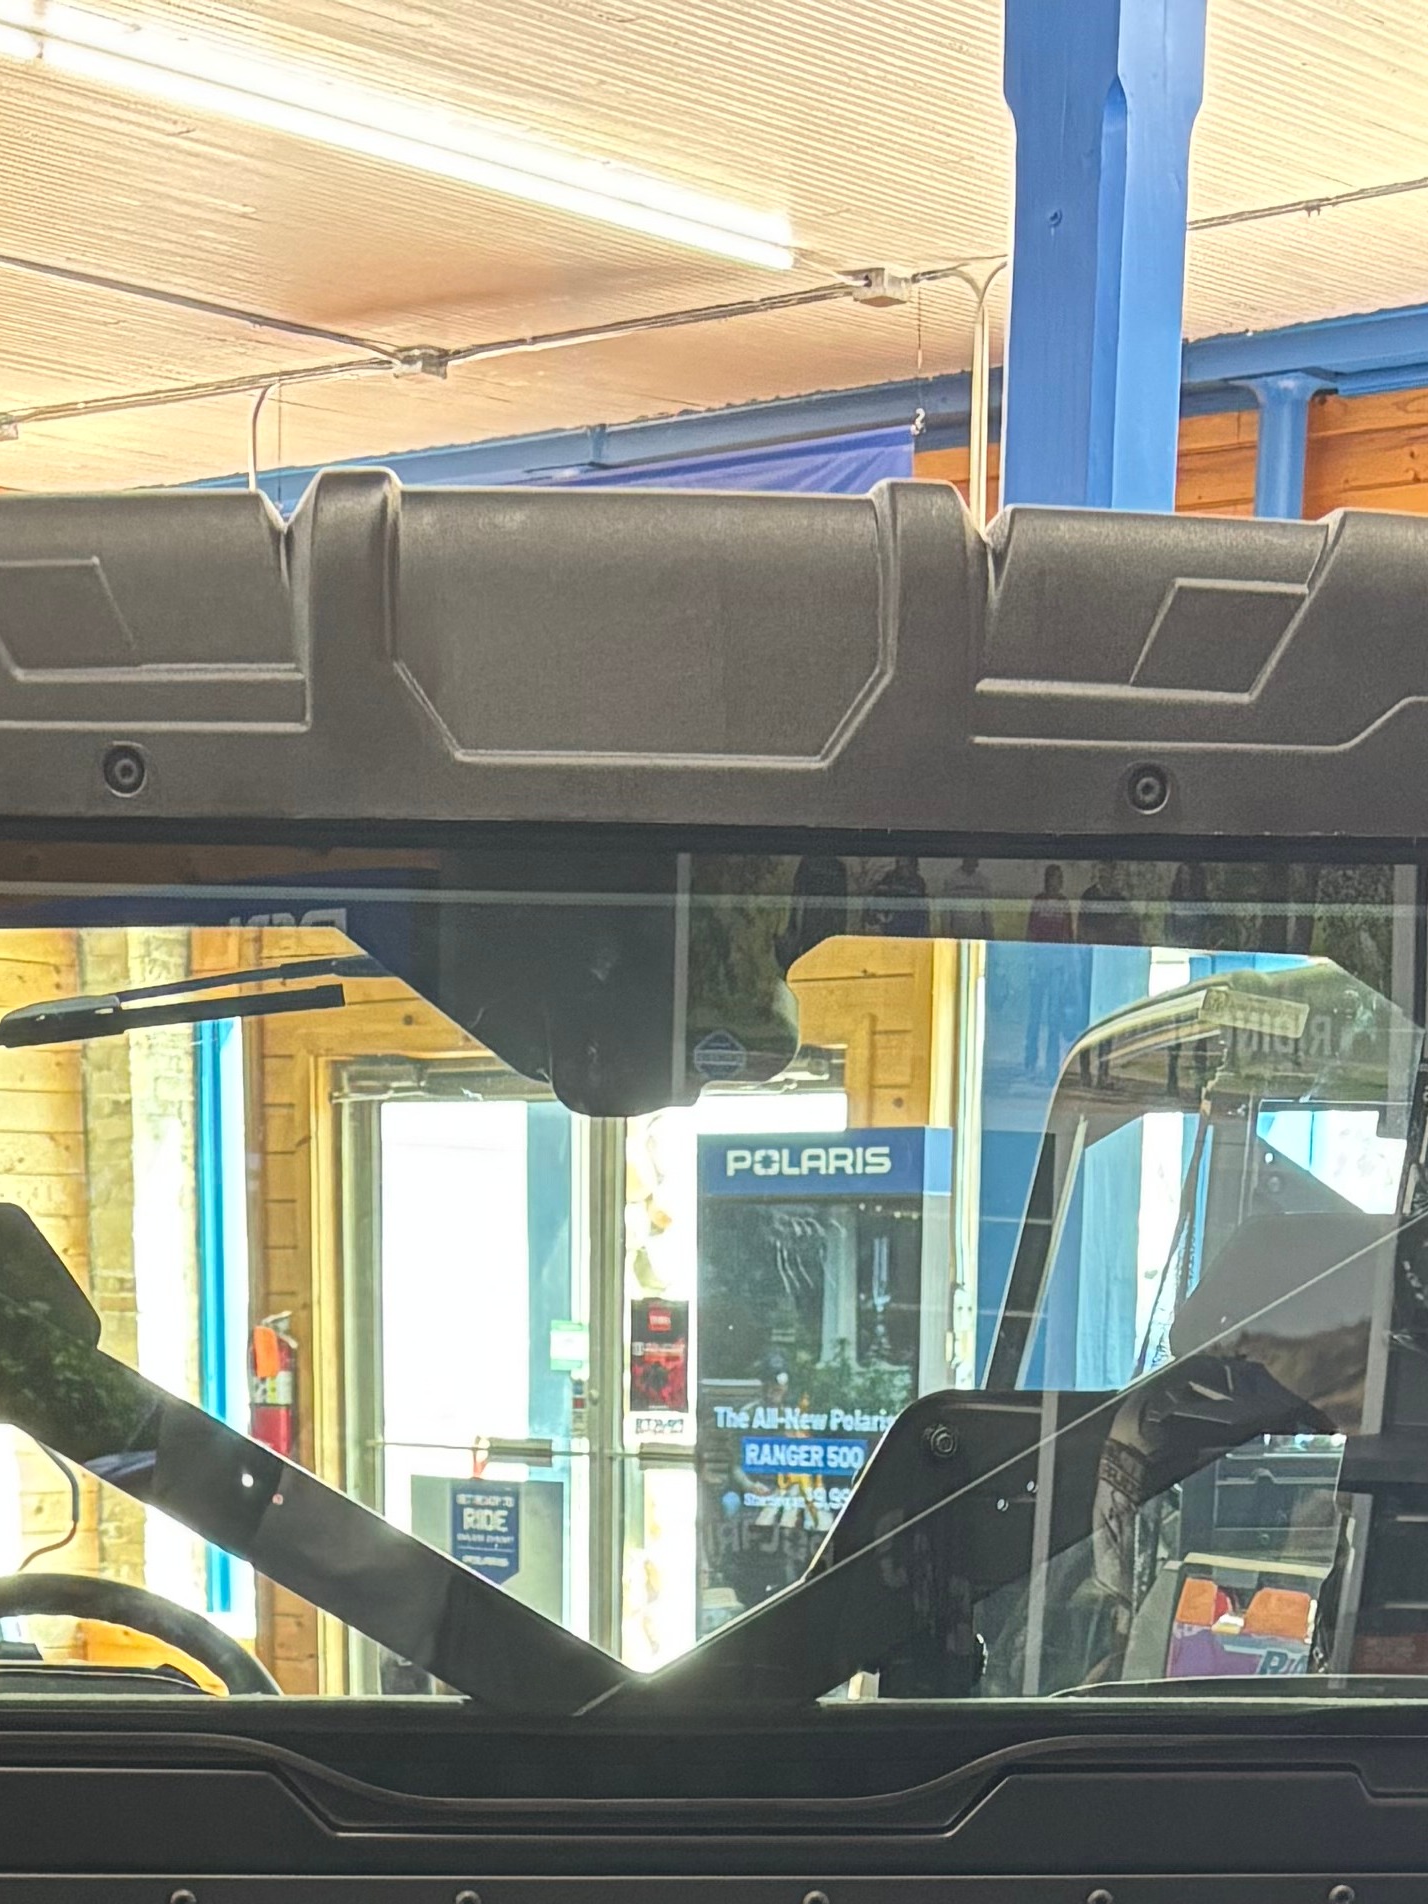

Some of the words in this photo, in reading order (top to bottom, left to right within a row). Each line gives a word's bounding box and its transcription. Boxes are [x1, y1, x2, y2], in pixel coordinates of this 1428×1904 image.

[726, 1146, 892, 1177] POLARIS
[713, 1405, 750, 1429] The
[752, 1406, 828, 1432] All-New
[744, 1442, 825, 1468] RANGER
[826, 1445, 866, 1469] 500
[463, 1507, 509, 1533] RIDE
